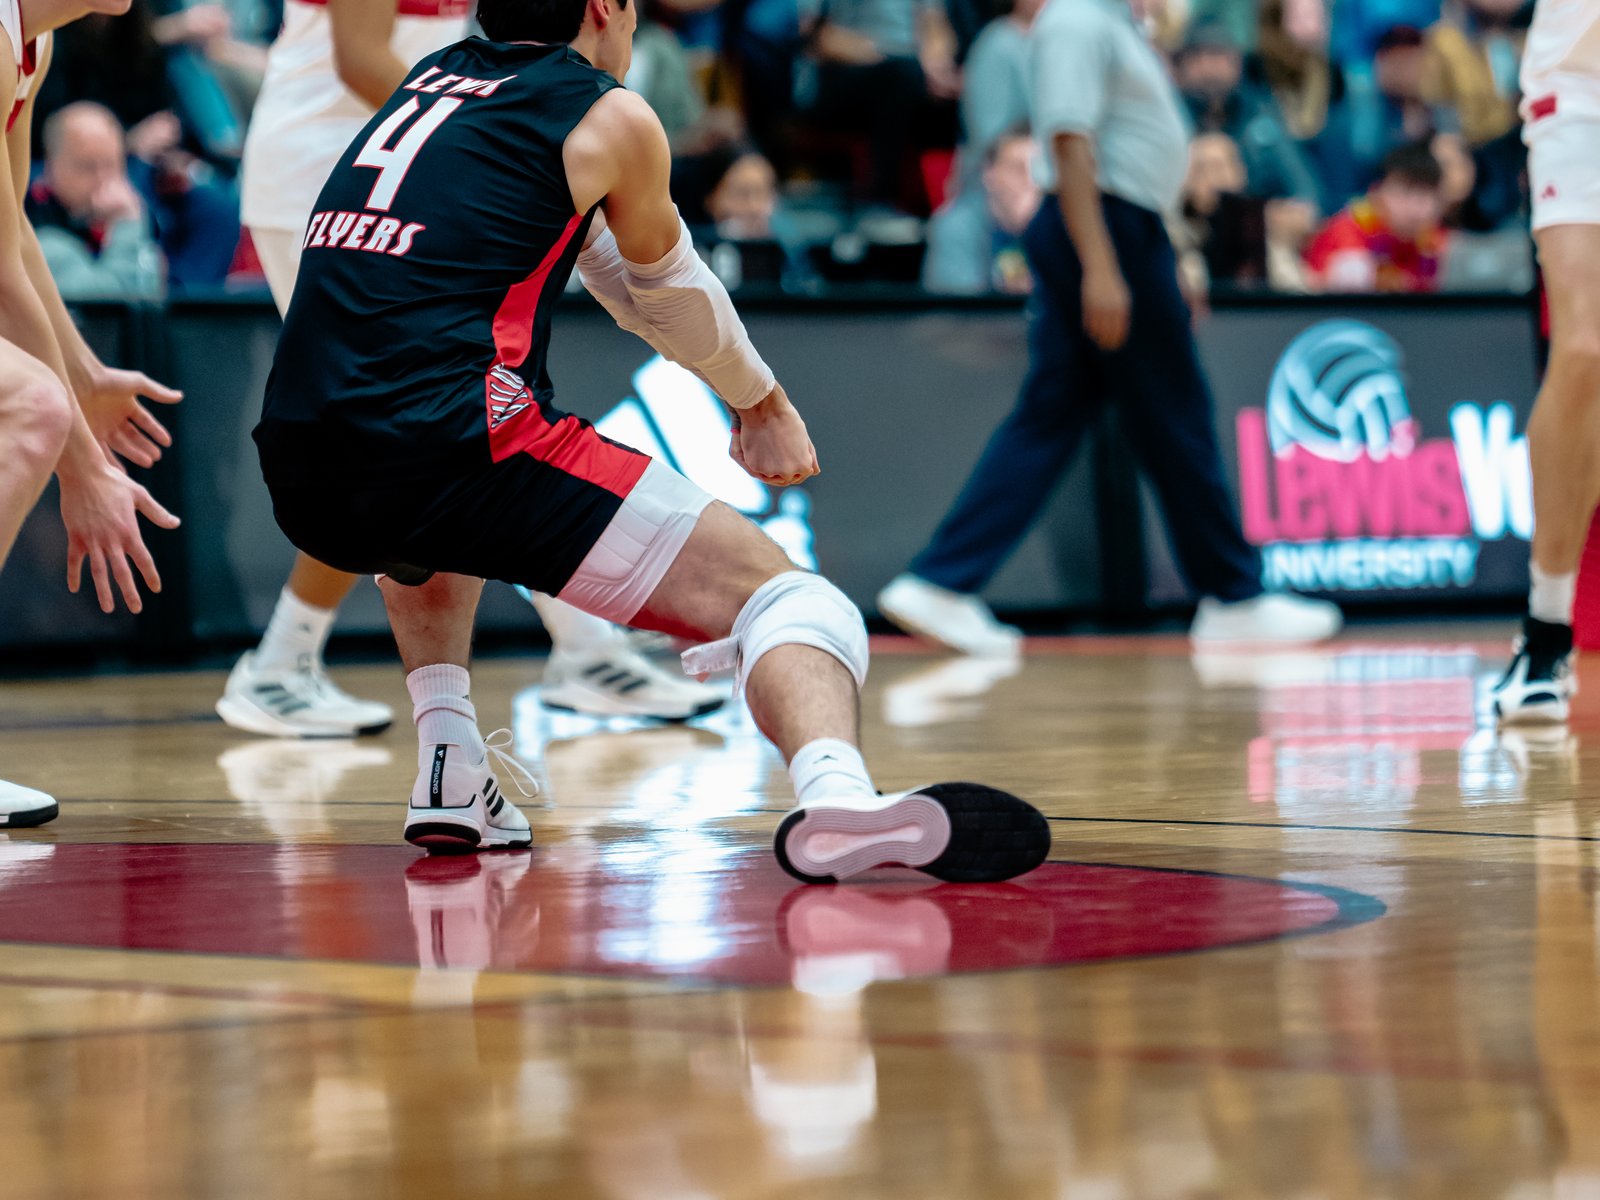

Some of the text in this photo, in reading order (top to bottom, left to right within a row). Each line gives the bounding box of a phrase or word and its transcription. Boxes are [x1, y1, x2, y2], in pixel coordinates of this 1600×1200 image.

[352, 94, 465, 212] 4
[302, 210, 427, 257] FLYERS
[1262, 538, 1478, 590] NIVERSITY
[432, 760, 442, 794] CRAZYFLIGHT
